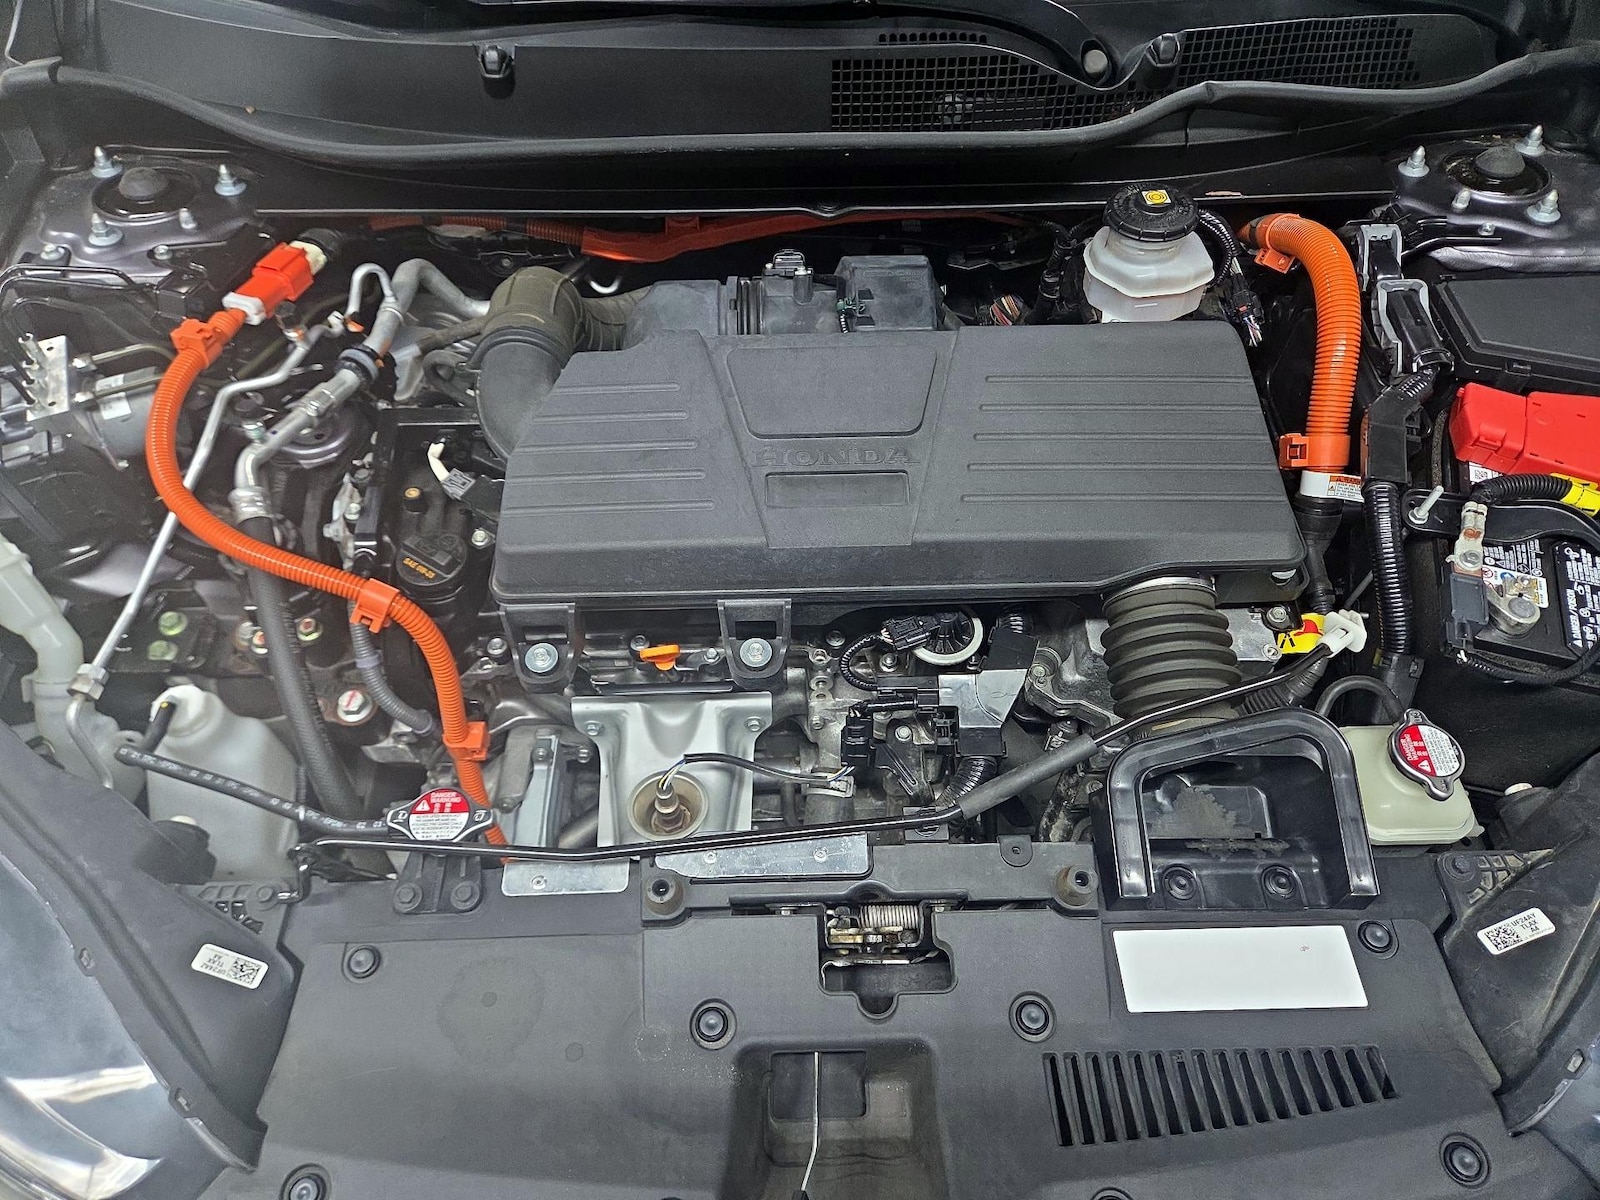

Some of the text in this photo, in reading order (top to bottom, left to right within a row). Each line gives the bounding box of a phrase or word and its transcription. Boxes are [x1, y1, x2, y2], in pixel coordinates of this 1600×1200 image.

[750, 447, 920, 467] HONDA
[1400, 738, 1413, 761] DANGER
[1510, 912, 1536, 927] UF24AY
[1520, 919, 1538, 930] TLAX
